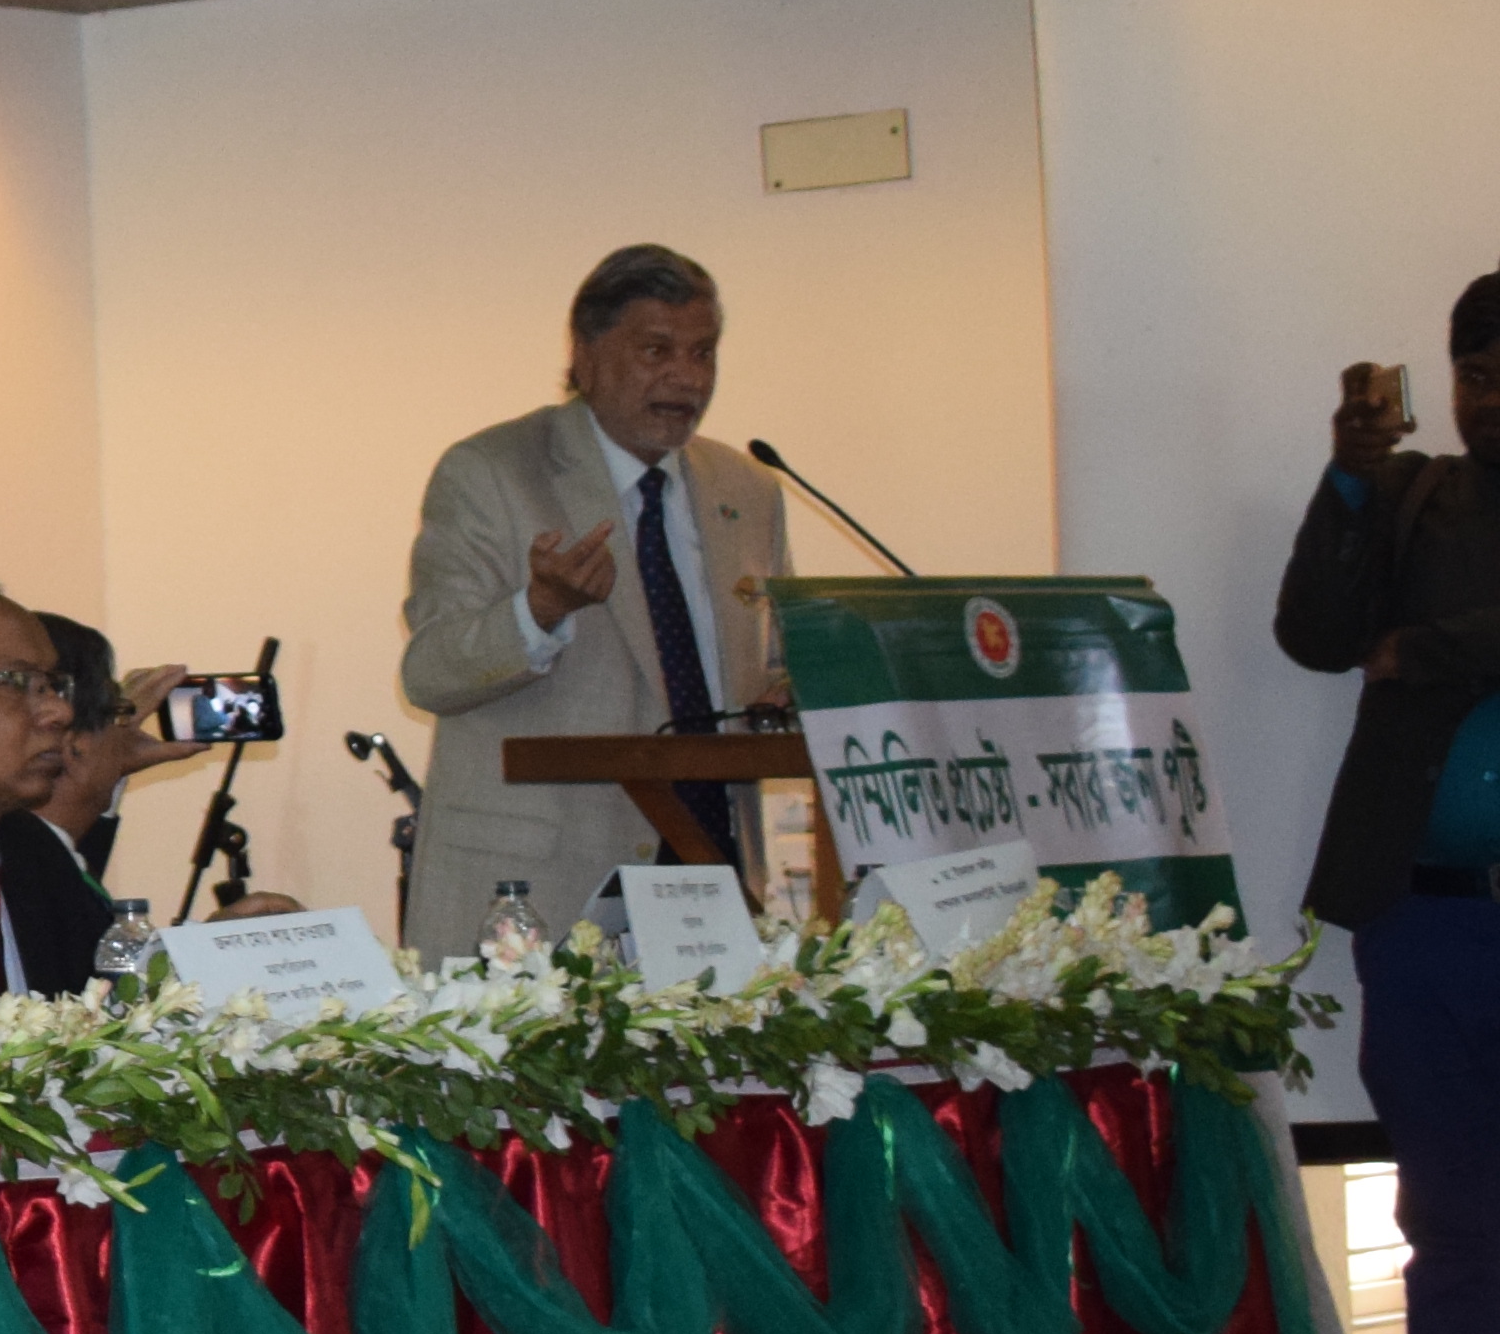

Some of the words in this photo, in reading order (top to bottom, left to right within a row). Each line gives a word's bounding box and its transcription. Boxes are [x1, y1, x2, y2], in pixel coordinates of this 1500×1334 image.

[825, 730, 949, 845] সম্মিলিত
[1037, 744, 1112, 833] সবার
[1163, 718, 1207, 845] পুষ্টি
